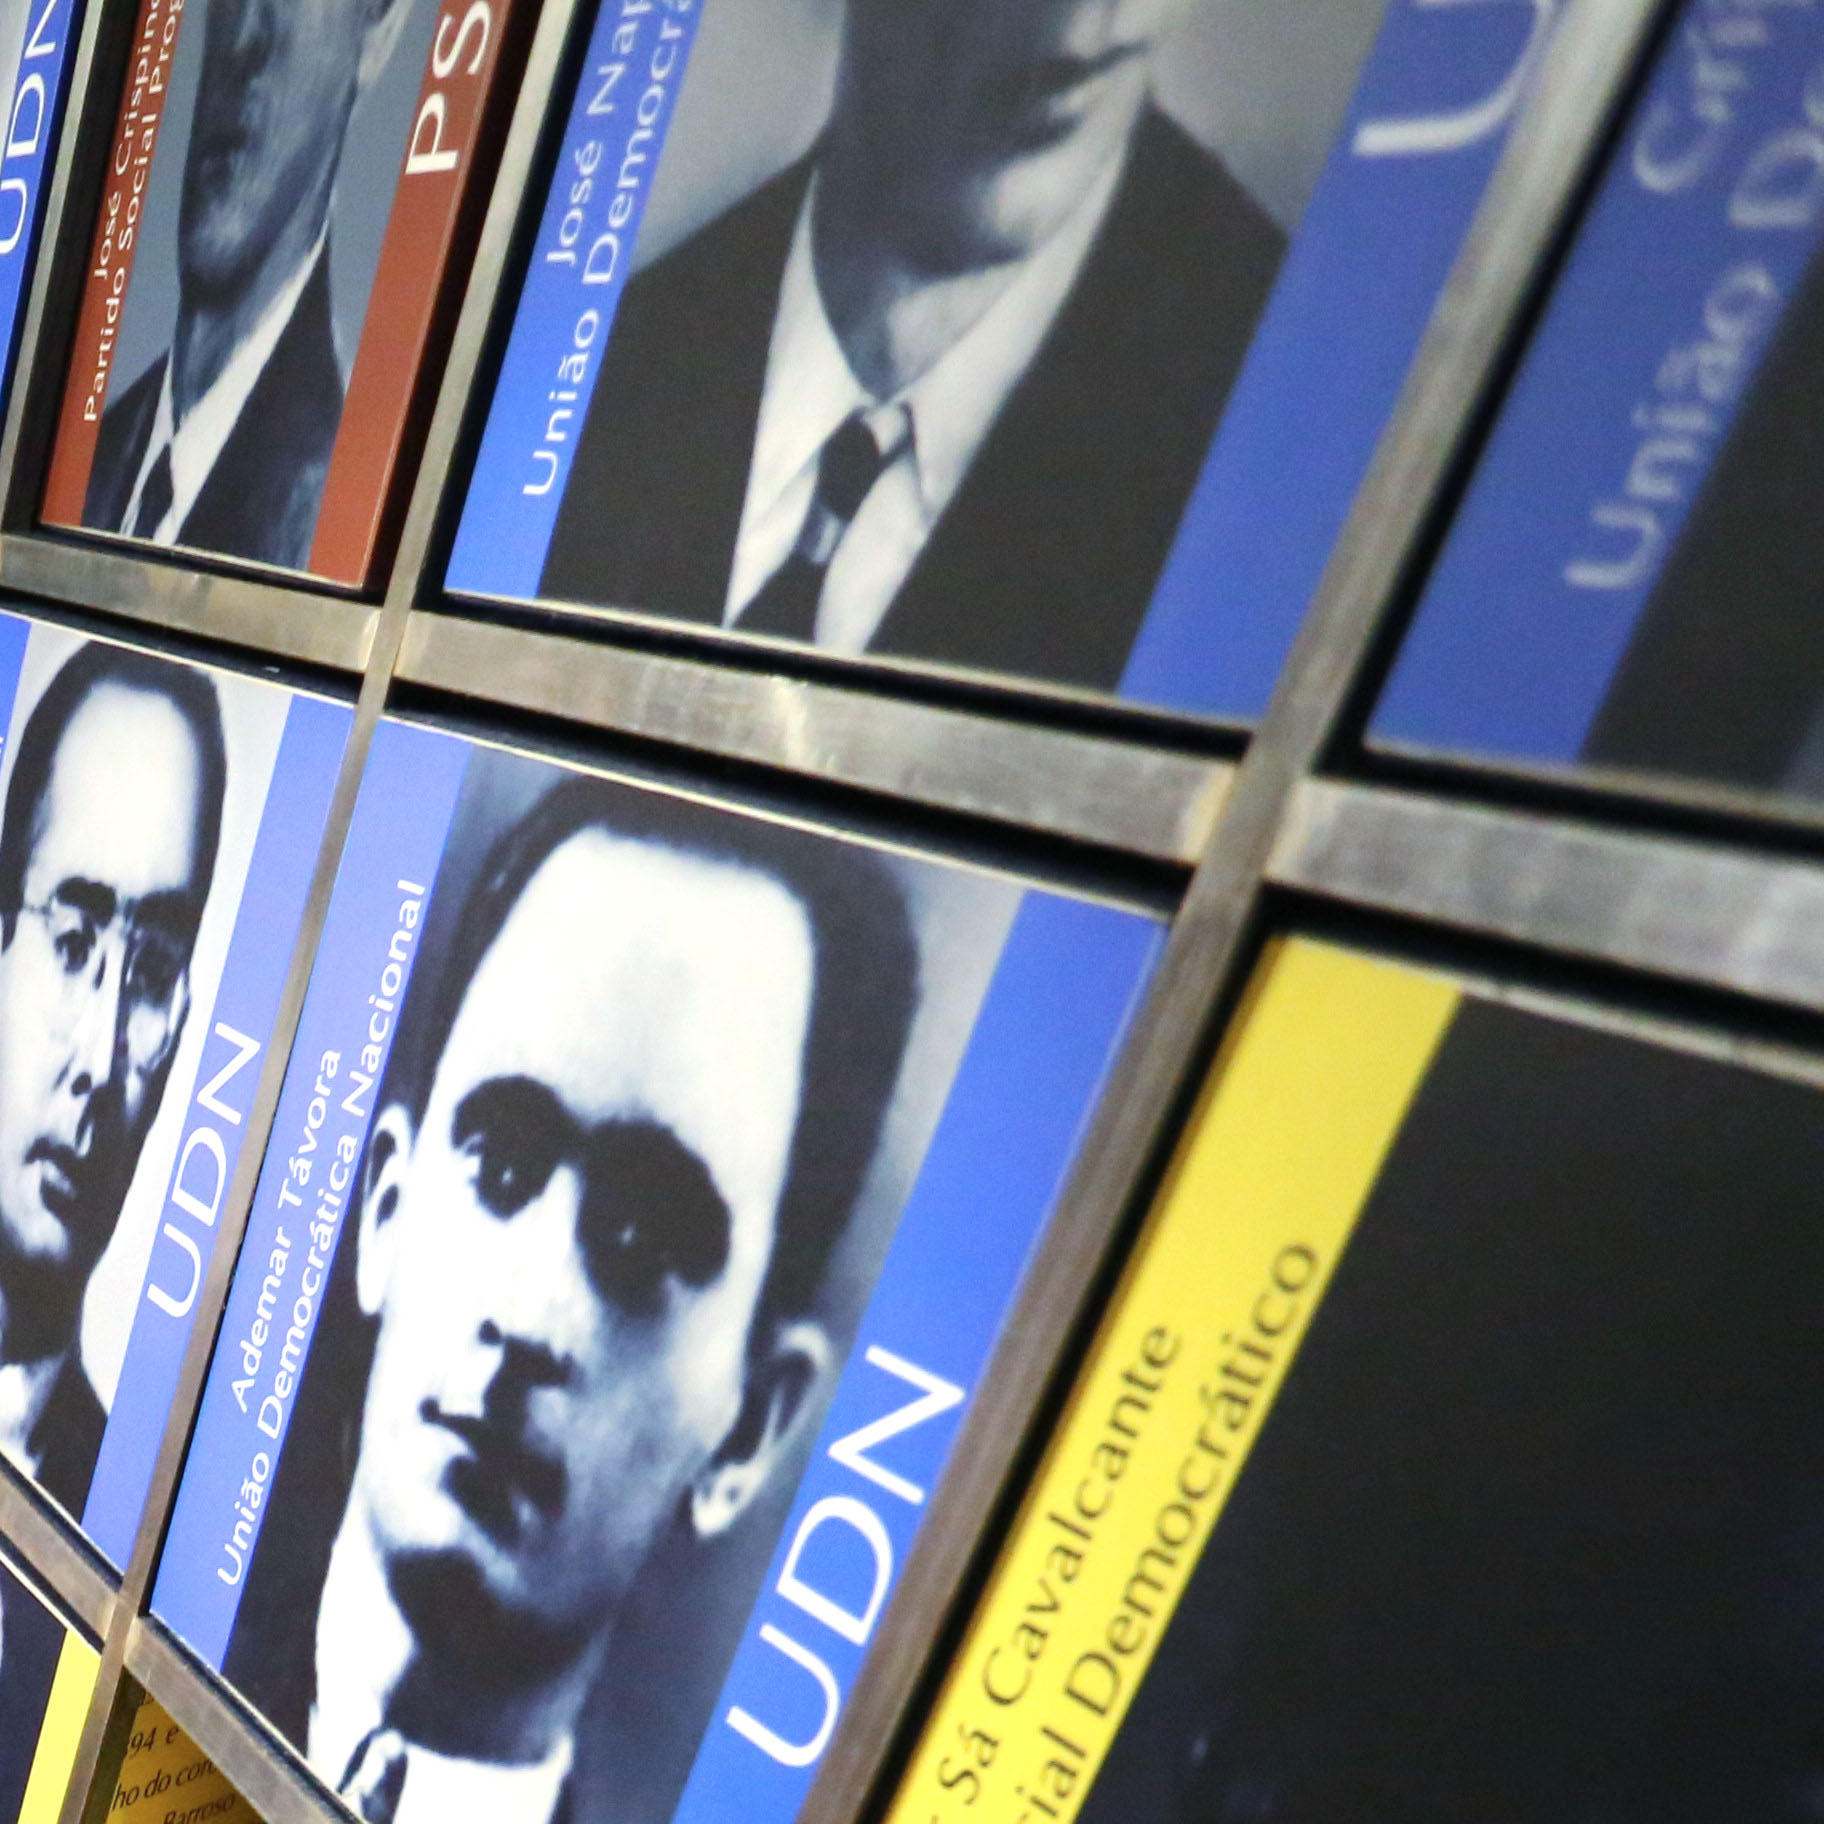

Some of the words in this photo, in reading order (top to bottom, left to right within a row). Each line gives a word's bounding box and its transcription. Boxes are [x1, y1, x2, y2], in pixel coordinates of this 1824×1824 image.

[83, 268, 127, 422] Partido
[120, 111, 156, 253] Social
[94, 190, 121, 283] José
[521, 308, 600, 497] União
[583, 0, 692, 285] Democr
[546, 139, 602, 267] José
[1563, 262, 1782, 592] União
[147, 1022, 263, 1319] UDN
[217, 1436, 272, 1588] União
[258, 1130, 361, 1422] Democrática
[341, 877, 426, 1118] Nacional
[232, 1219, 293, 1414] Ademar
[276, 1047, 342, 1209] Távora
[725, 1344, 967, 1769] UDN
[939, 1719, 1003, 1808] Sá
[981, 1323, 1184, 1712] Cavalcante
[1063, 1242, 1321, 1721] Democrático
[112, 1783, 140, 1812] ho
[143, 1768, 172, 1798] do
